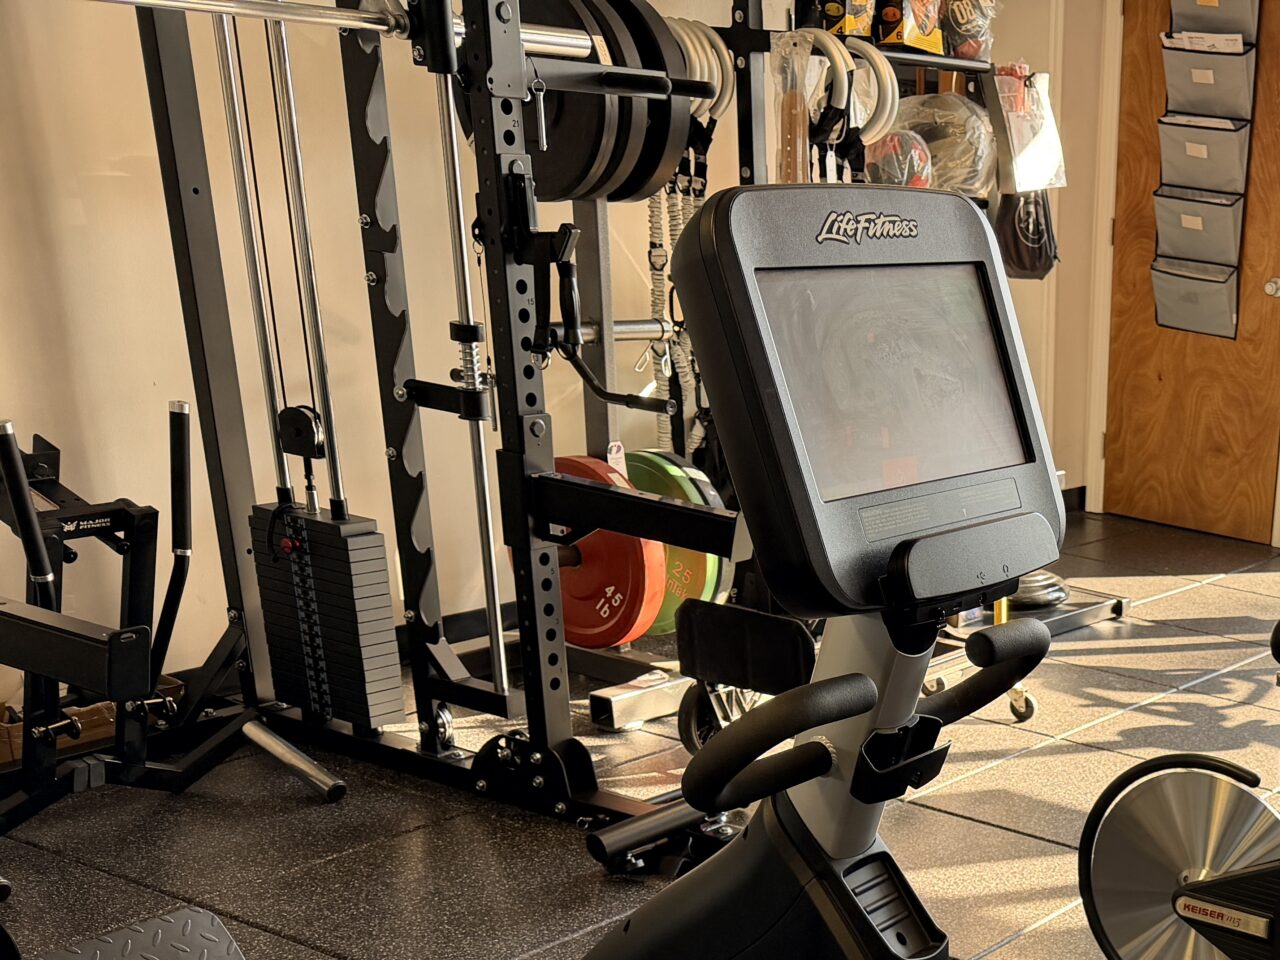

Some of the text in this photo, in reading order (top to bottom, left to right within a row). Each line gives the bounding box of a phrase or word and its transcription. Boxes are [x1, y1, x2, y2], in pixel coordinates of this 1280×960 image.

[671, 561, 693, 585] 25
[604, 584, 624, 607] 45
[1183, 903, 1225, 921] KEISER
